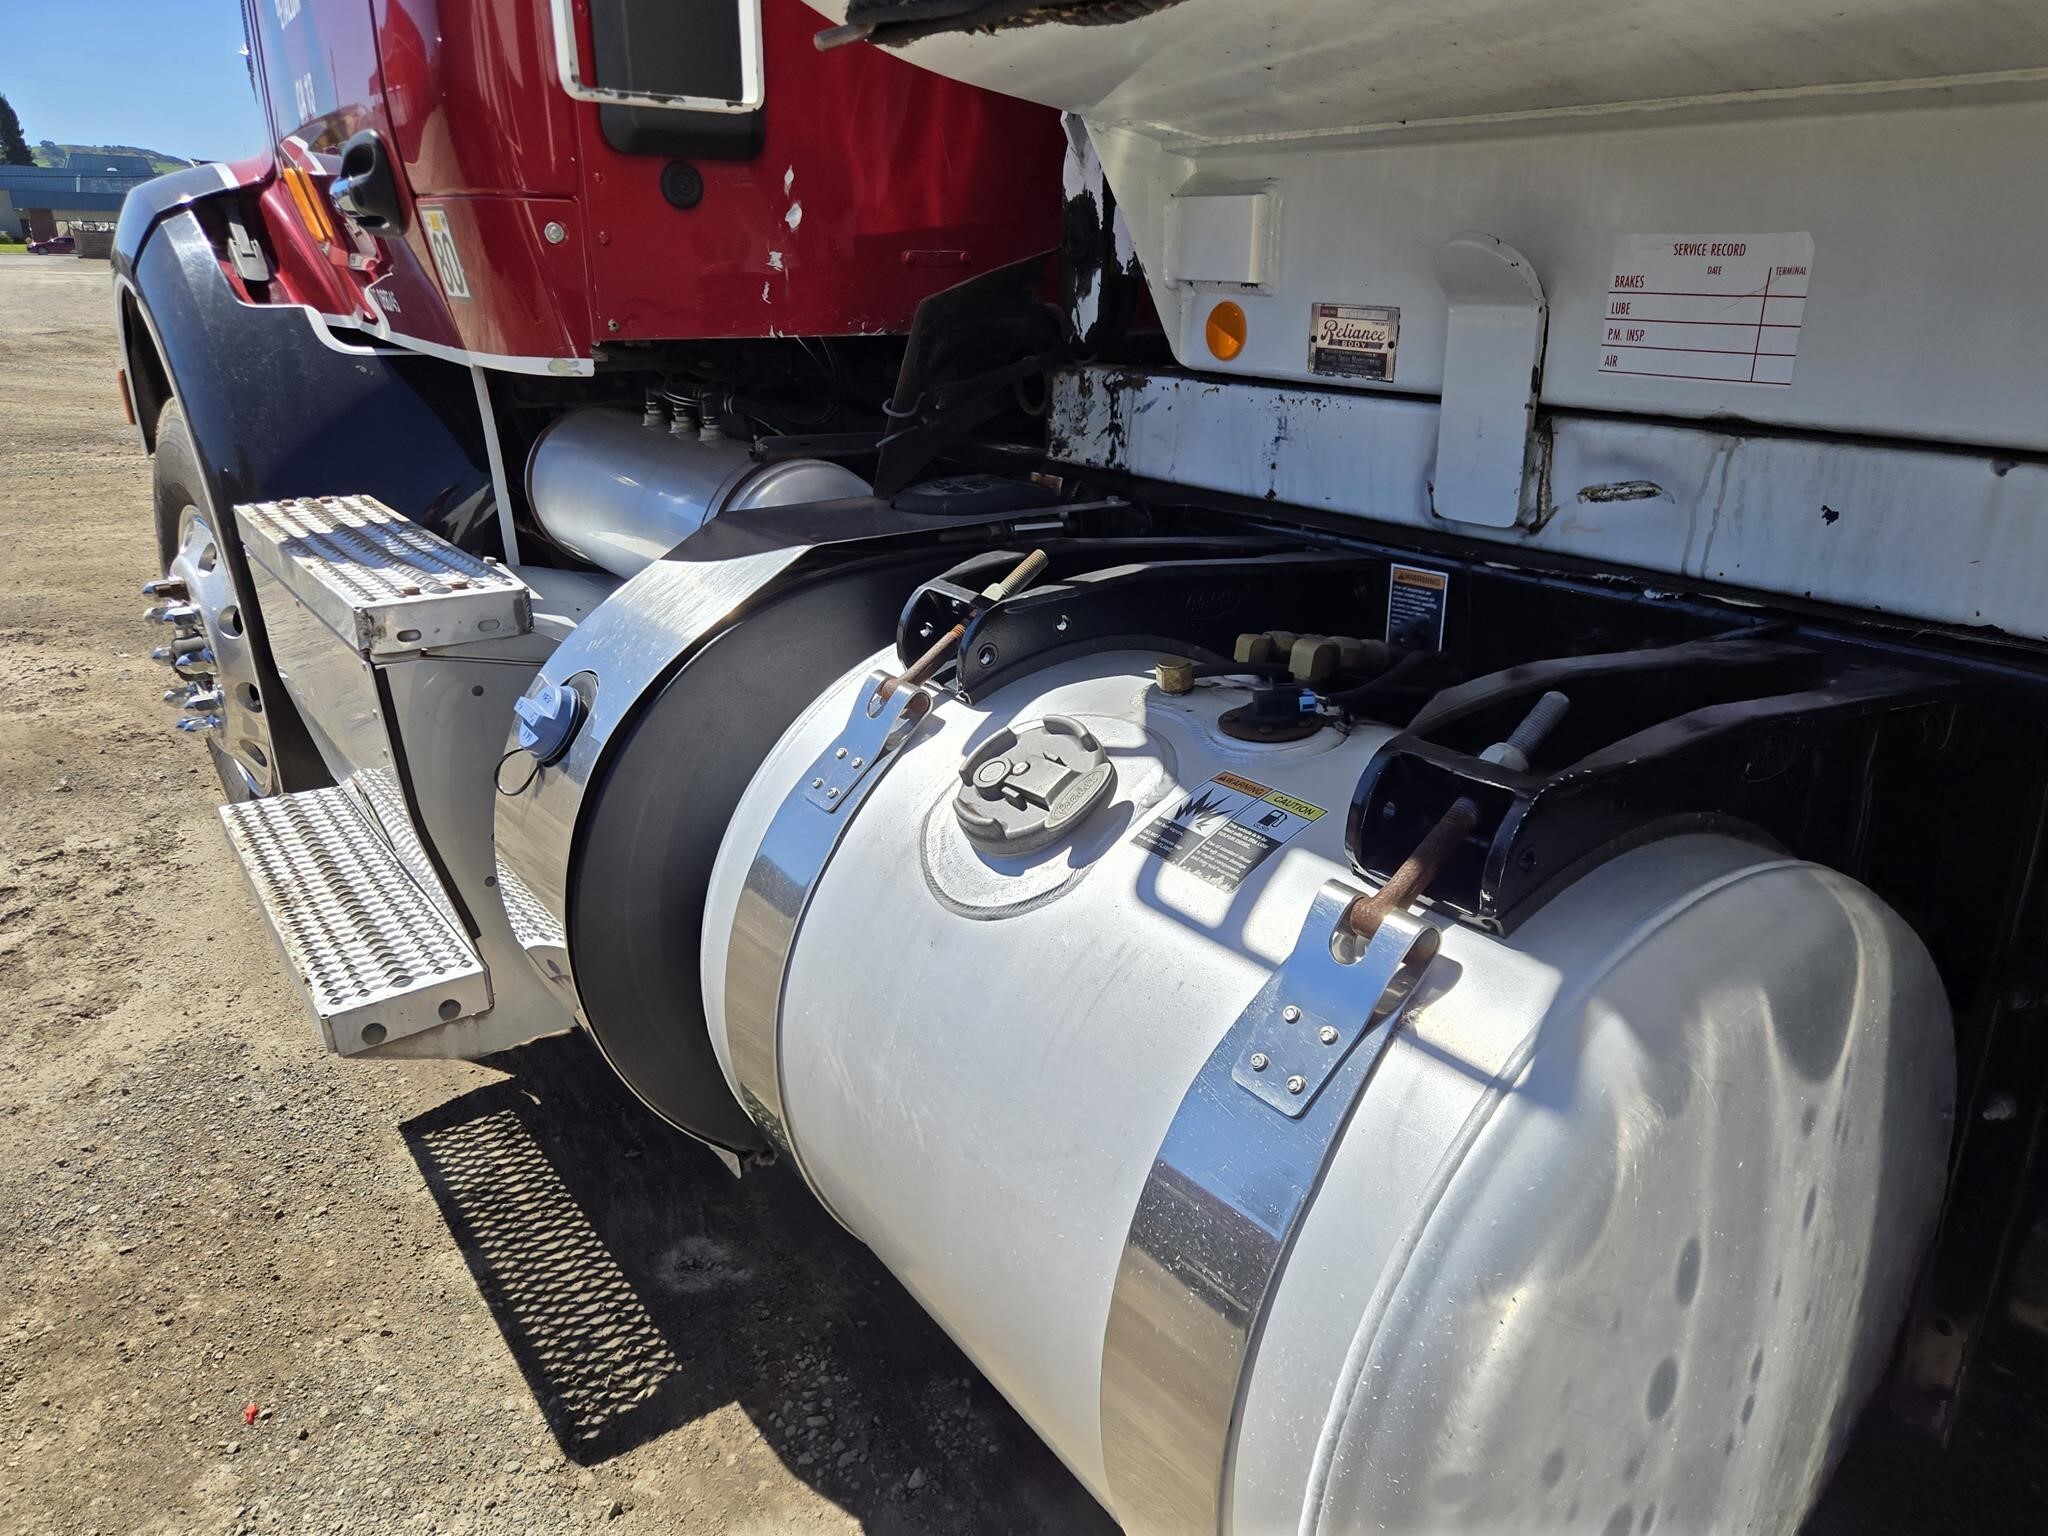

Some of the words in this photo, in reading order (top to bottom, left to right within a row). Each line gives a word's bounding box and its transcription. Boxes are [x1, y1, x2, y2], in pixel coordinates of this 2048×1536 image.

[1673, 243, 1706, 256] SERVICE
[1710, 243, 1746, 257] RECORD
[433, 232, 464, 294] 80
[1707, 265, 1722, 275] DATE
[1775, 265, 1807, 276] TERMINAL
[1614, 275, 1645, 288] BRAKES
[1610, 302, 1631, 315] LUBE
[1321, 320, 1386, 342] Reliance
[1607, 328, 1622, 341] P.M.
[1626, 329, 1645, 342] INSP.
[1342, 340, 1367, 348] BODY
[1604, 354, 1618, 367] AIR
[1404, 572, 1441, 587] WARNING
[1224, 777, 1265, 795] WARNING
[1274, 796, 1316, 816] CAUTION
